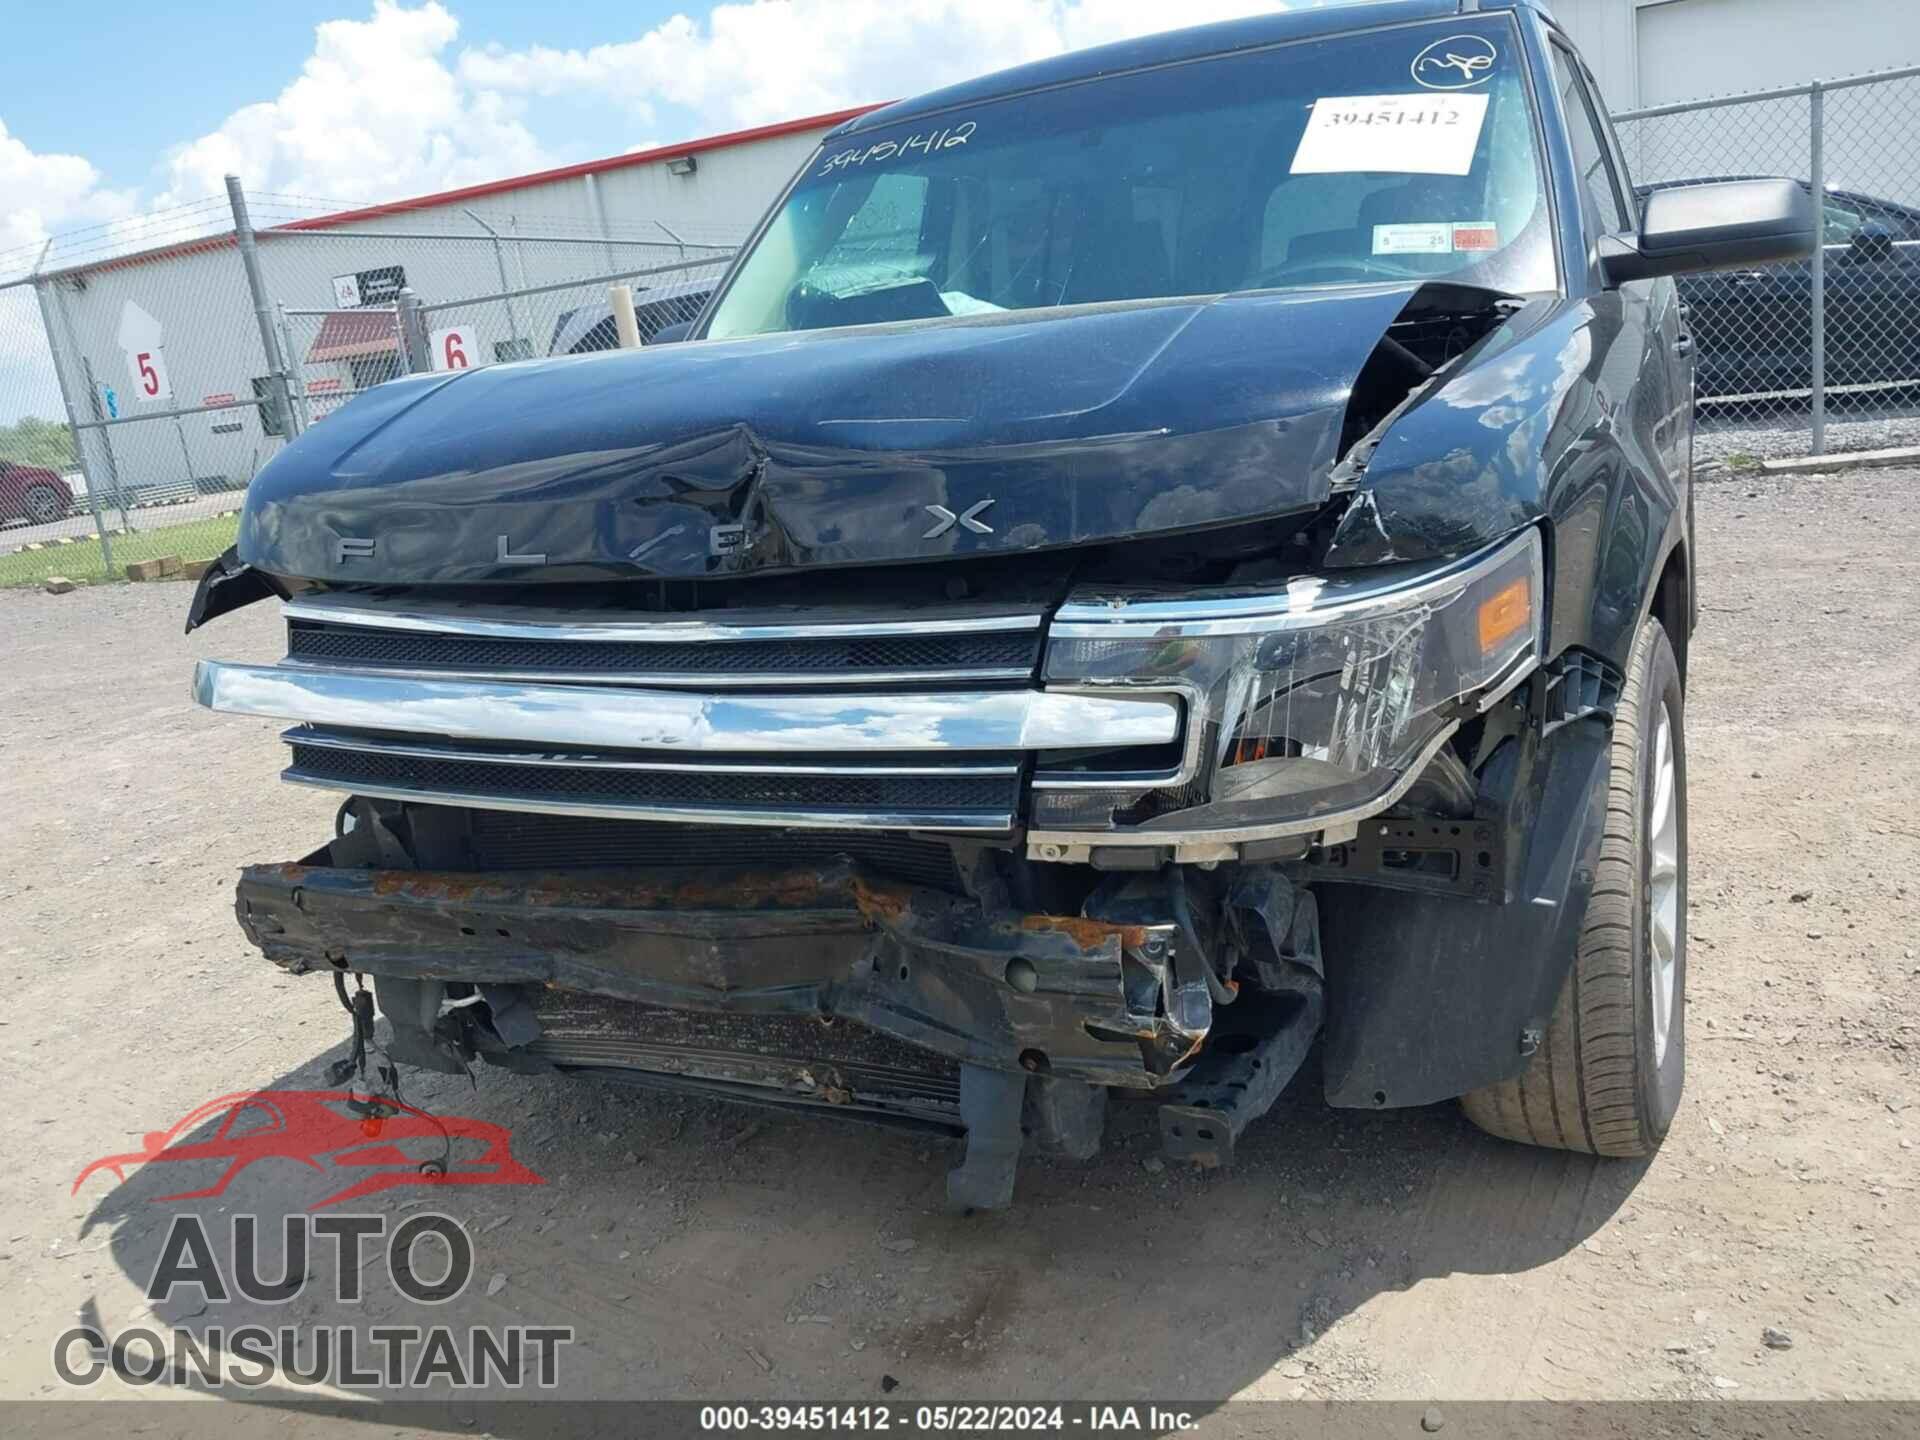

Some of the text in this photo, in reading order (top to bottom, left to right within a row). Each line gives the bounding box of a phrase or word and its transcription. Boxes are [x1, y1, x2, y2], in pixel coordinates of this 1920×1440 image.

[1323, 110, 1461, 128] 39451412
[817, 121, 977, 177] 39451412
[445, 332, 468, 369] 6
[136, 352, 159, 396] 5
